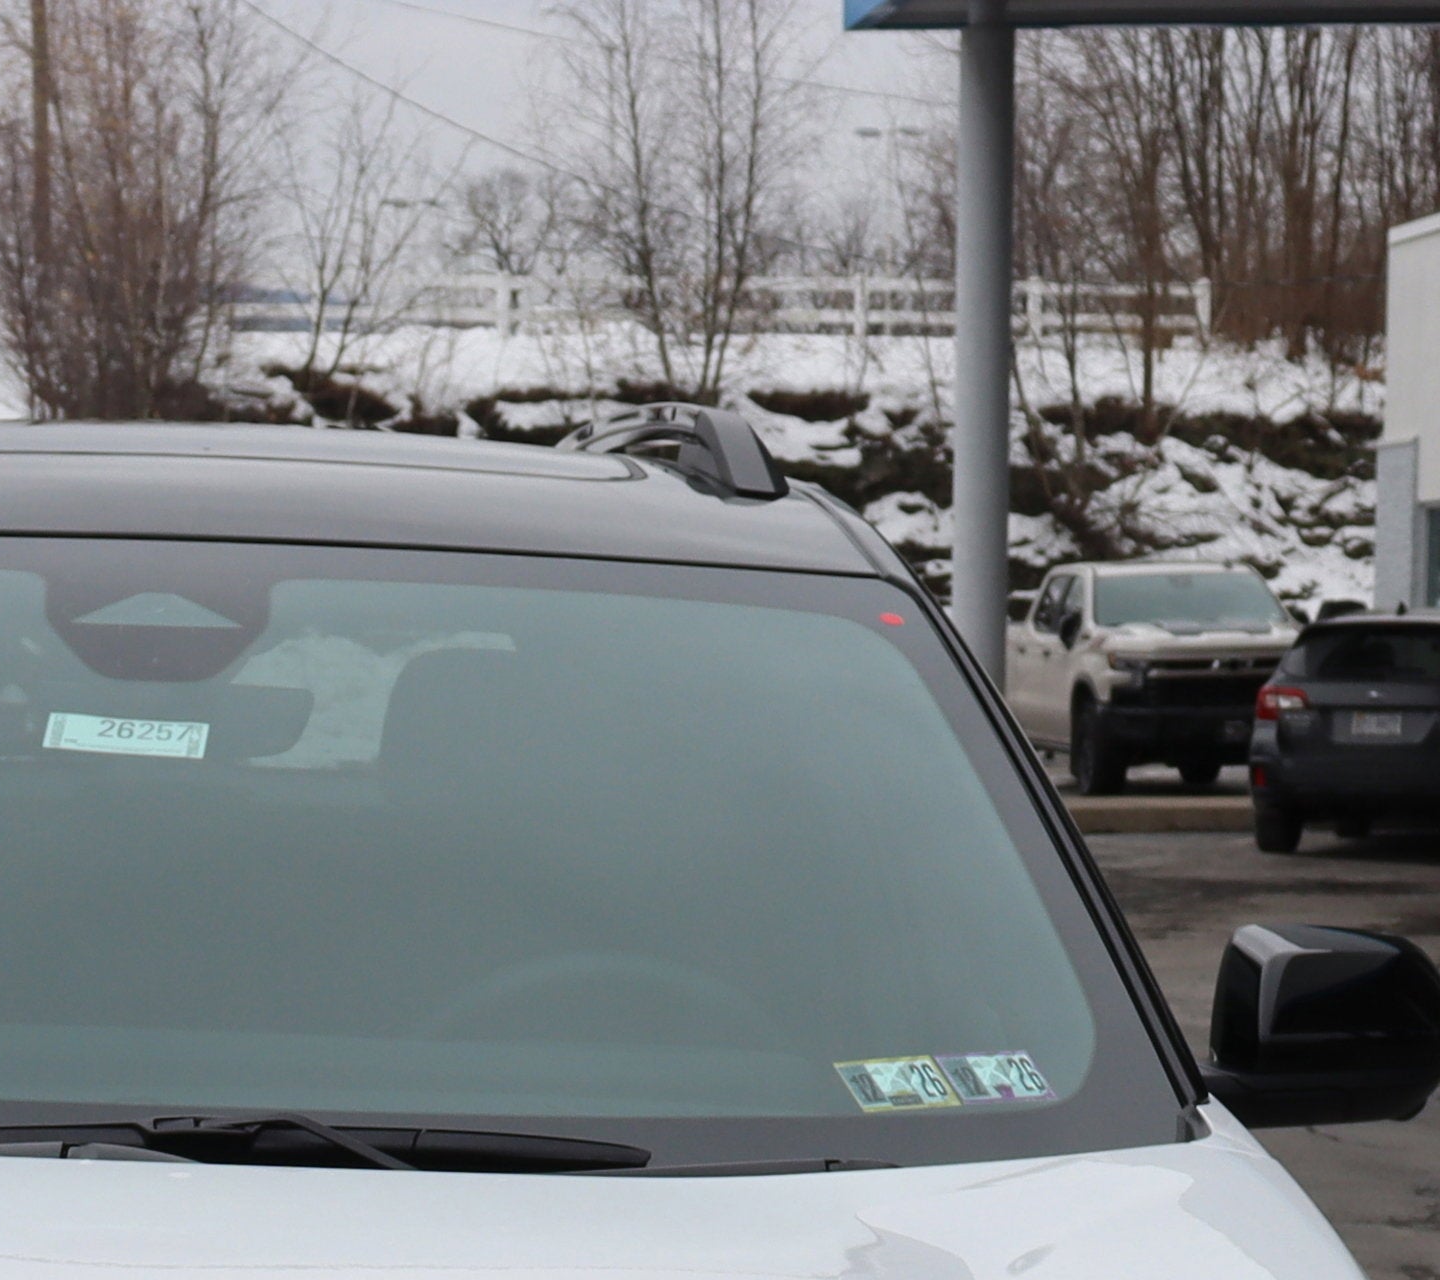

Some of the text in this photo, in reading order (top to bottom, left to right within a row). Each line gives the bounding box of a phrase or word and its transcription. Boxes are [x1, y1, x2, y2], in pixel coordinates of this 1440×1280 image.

[97, 719, 193, 742] 26257
[850, 1063, 948, 1103] 12 26
[953, 1057, 1045, 1097] 12 26
